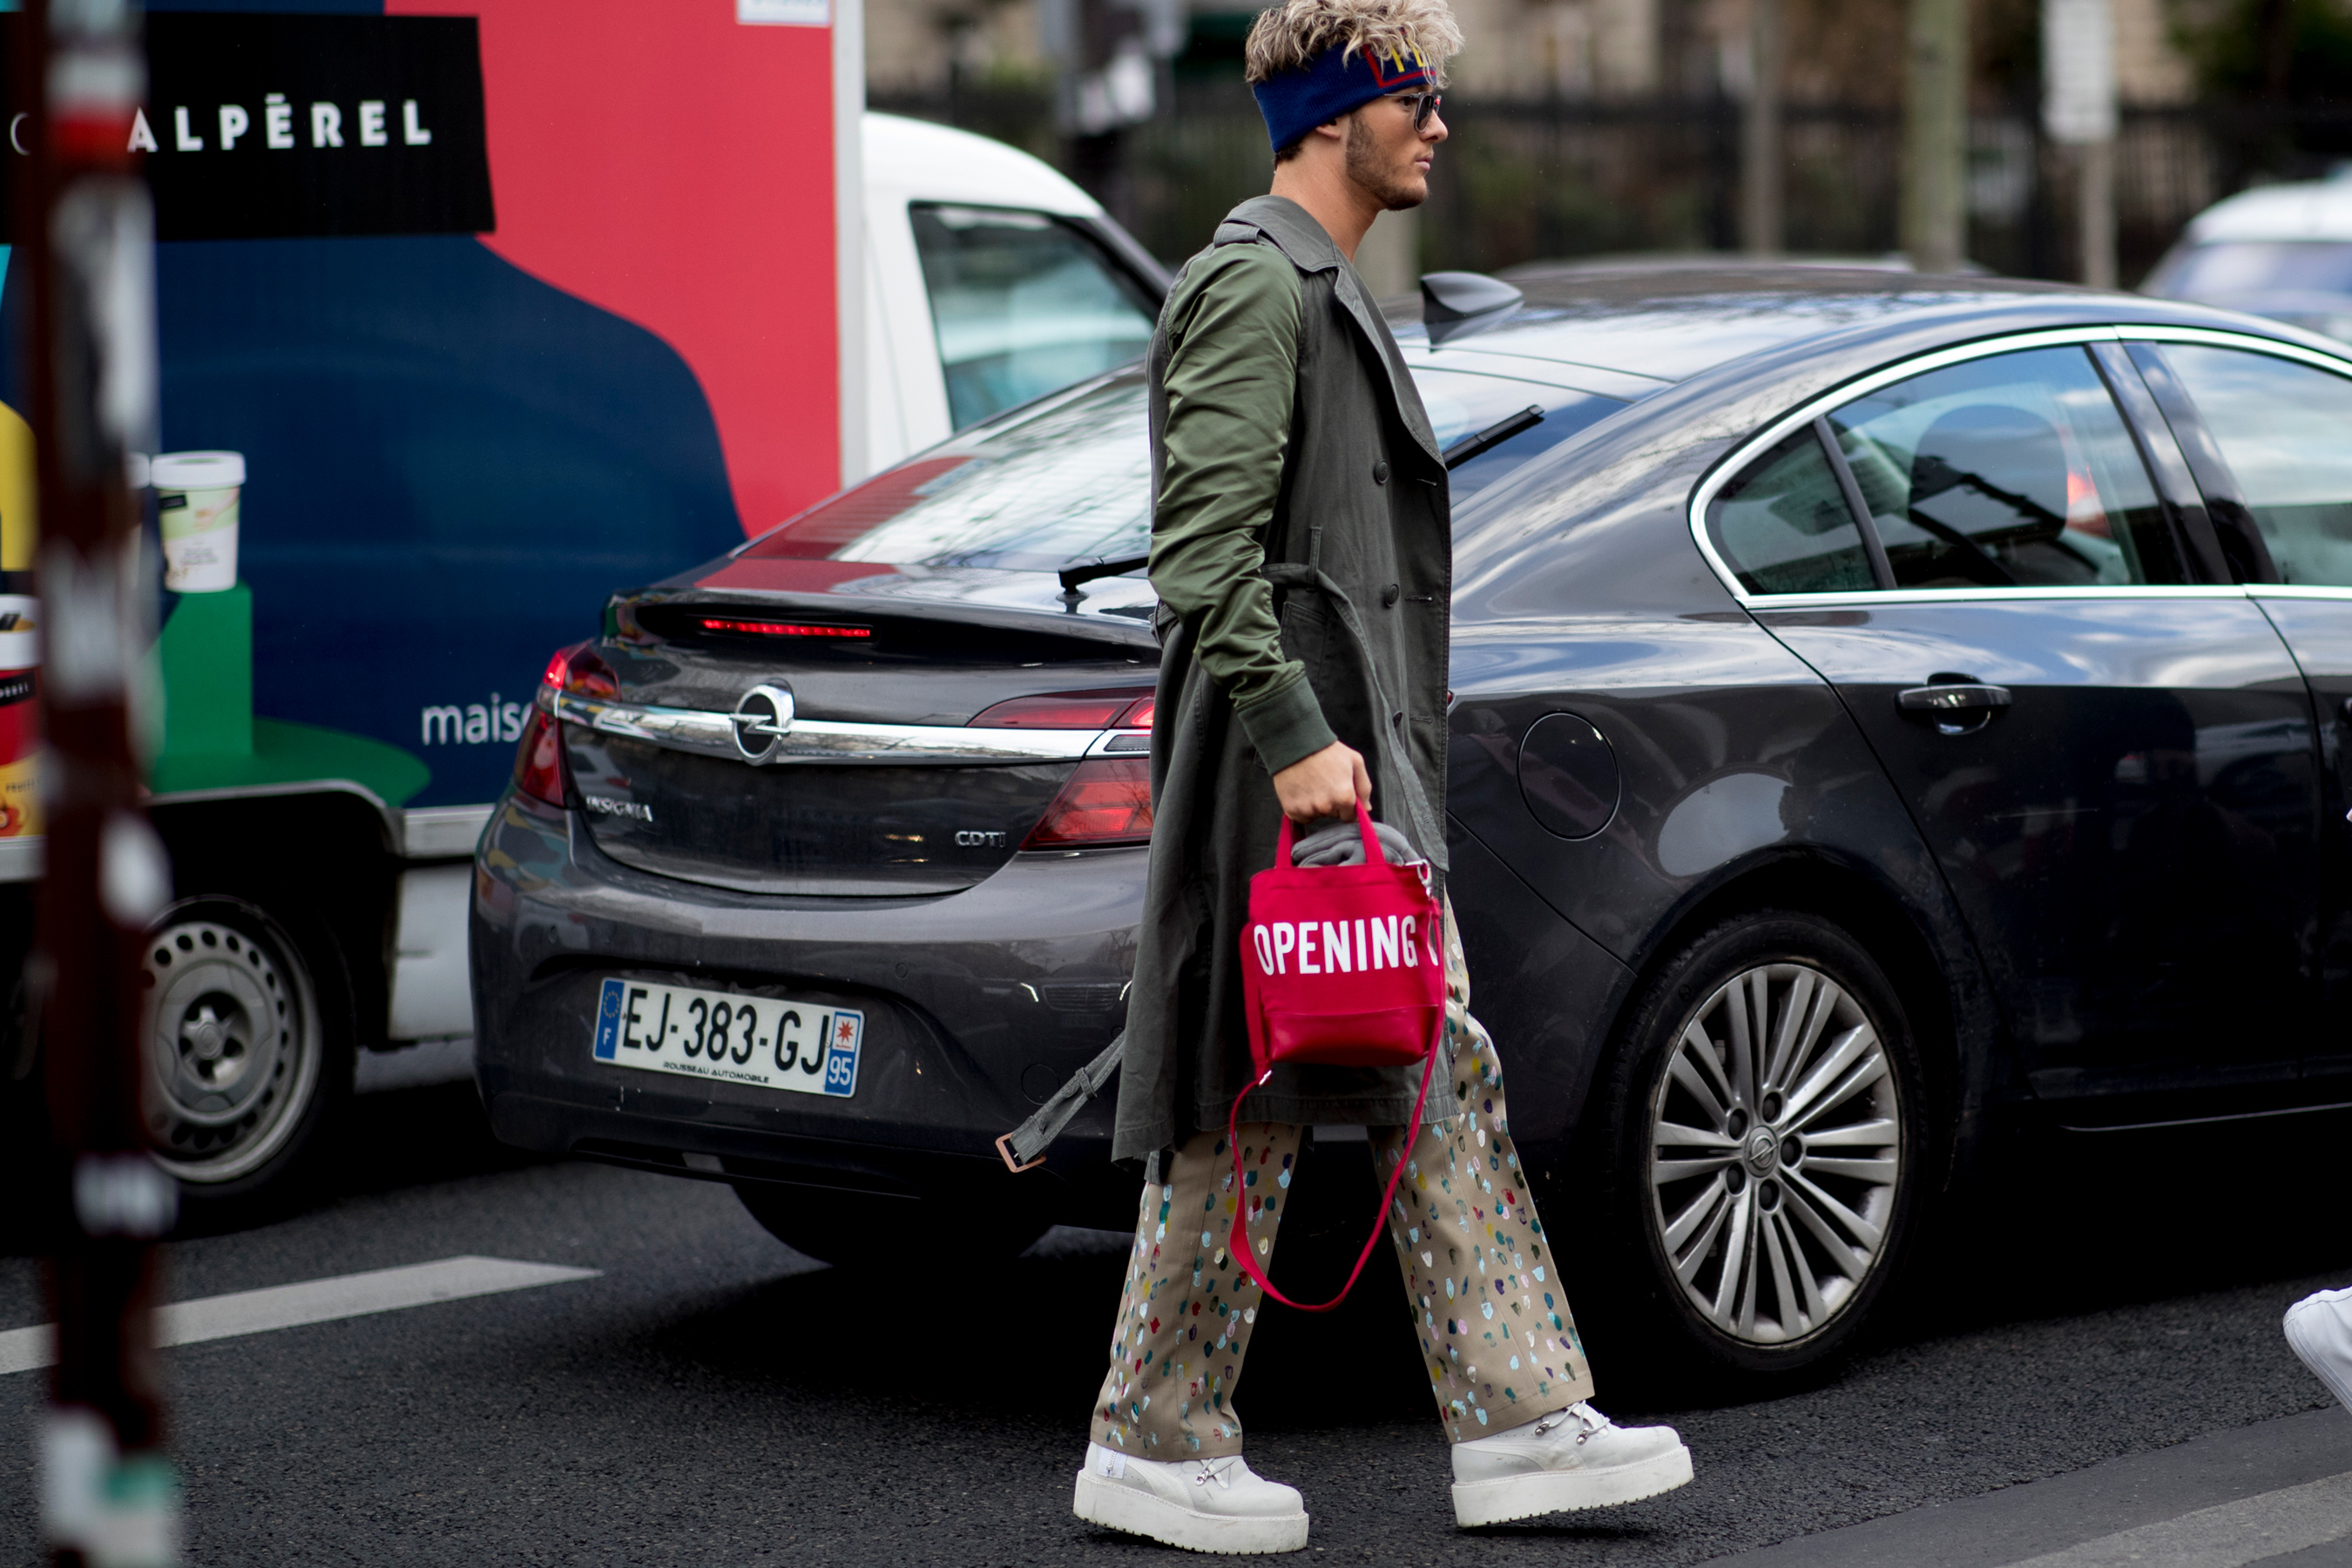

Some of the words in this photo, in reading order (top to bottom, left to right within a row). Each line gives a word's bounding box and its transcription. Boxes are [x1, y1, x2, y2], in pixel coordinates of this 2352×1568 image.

[422, 692, 533, 746] mais
[955, 830, 1006, 848] CDTI
[1254, 915, 1418, 976] OPENING
[603, 1027, 612, 1045] F
[623, 987, 829, 1076] EJ-383-GJ
[663, 1061, 710, 1075] ROUSSEAU
[711, 1068, 770, 1085] AUTOMOBILE
[828, 1055, 852, 1086] 95
